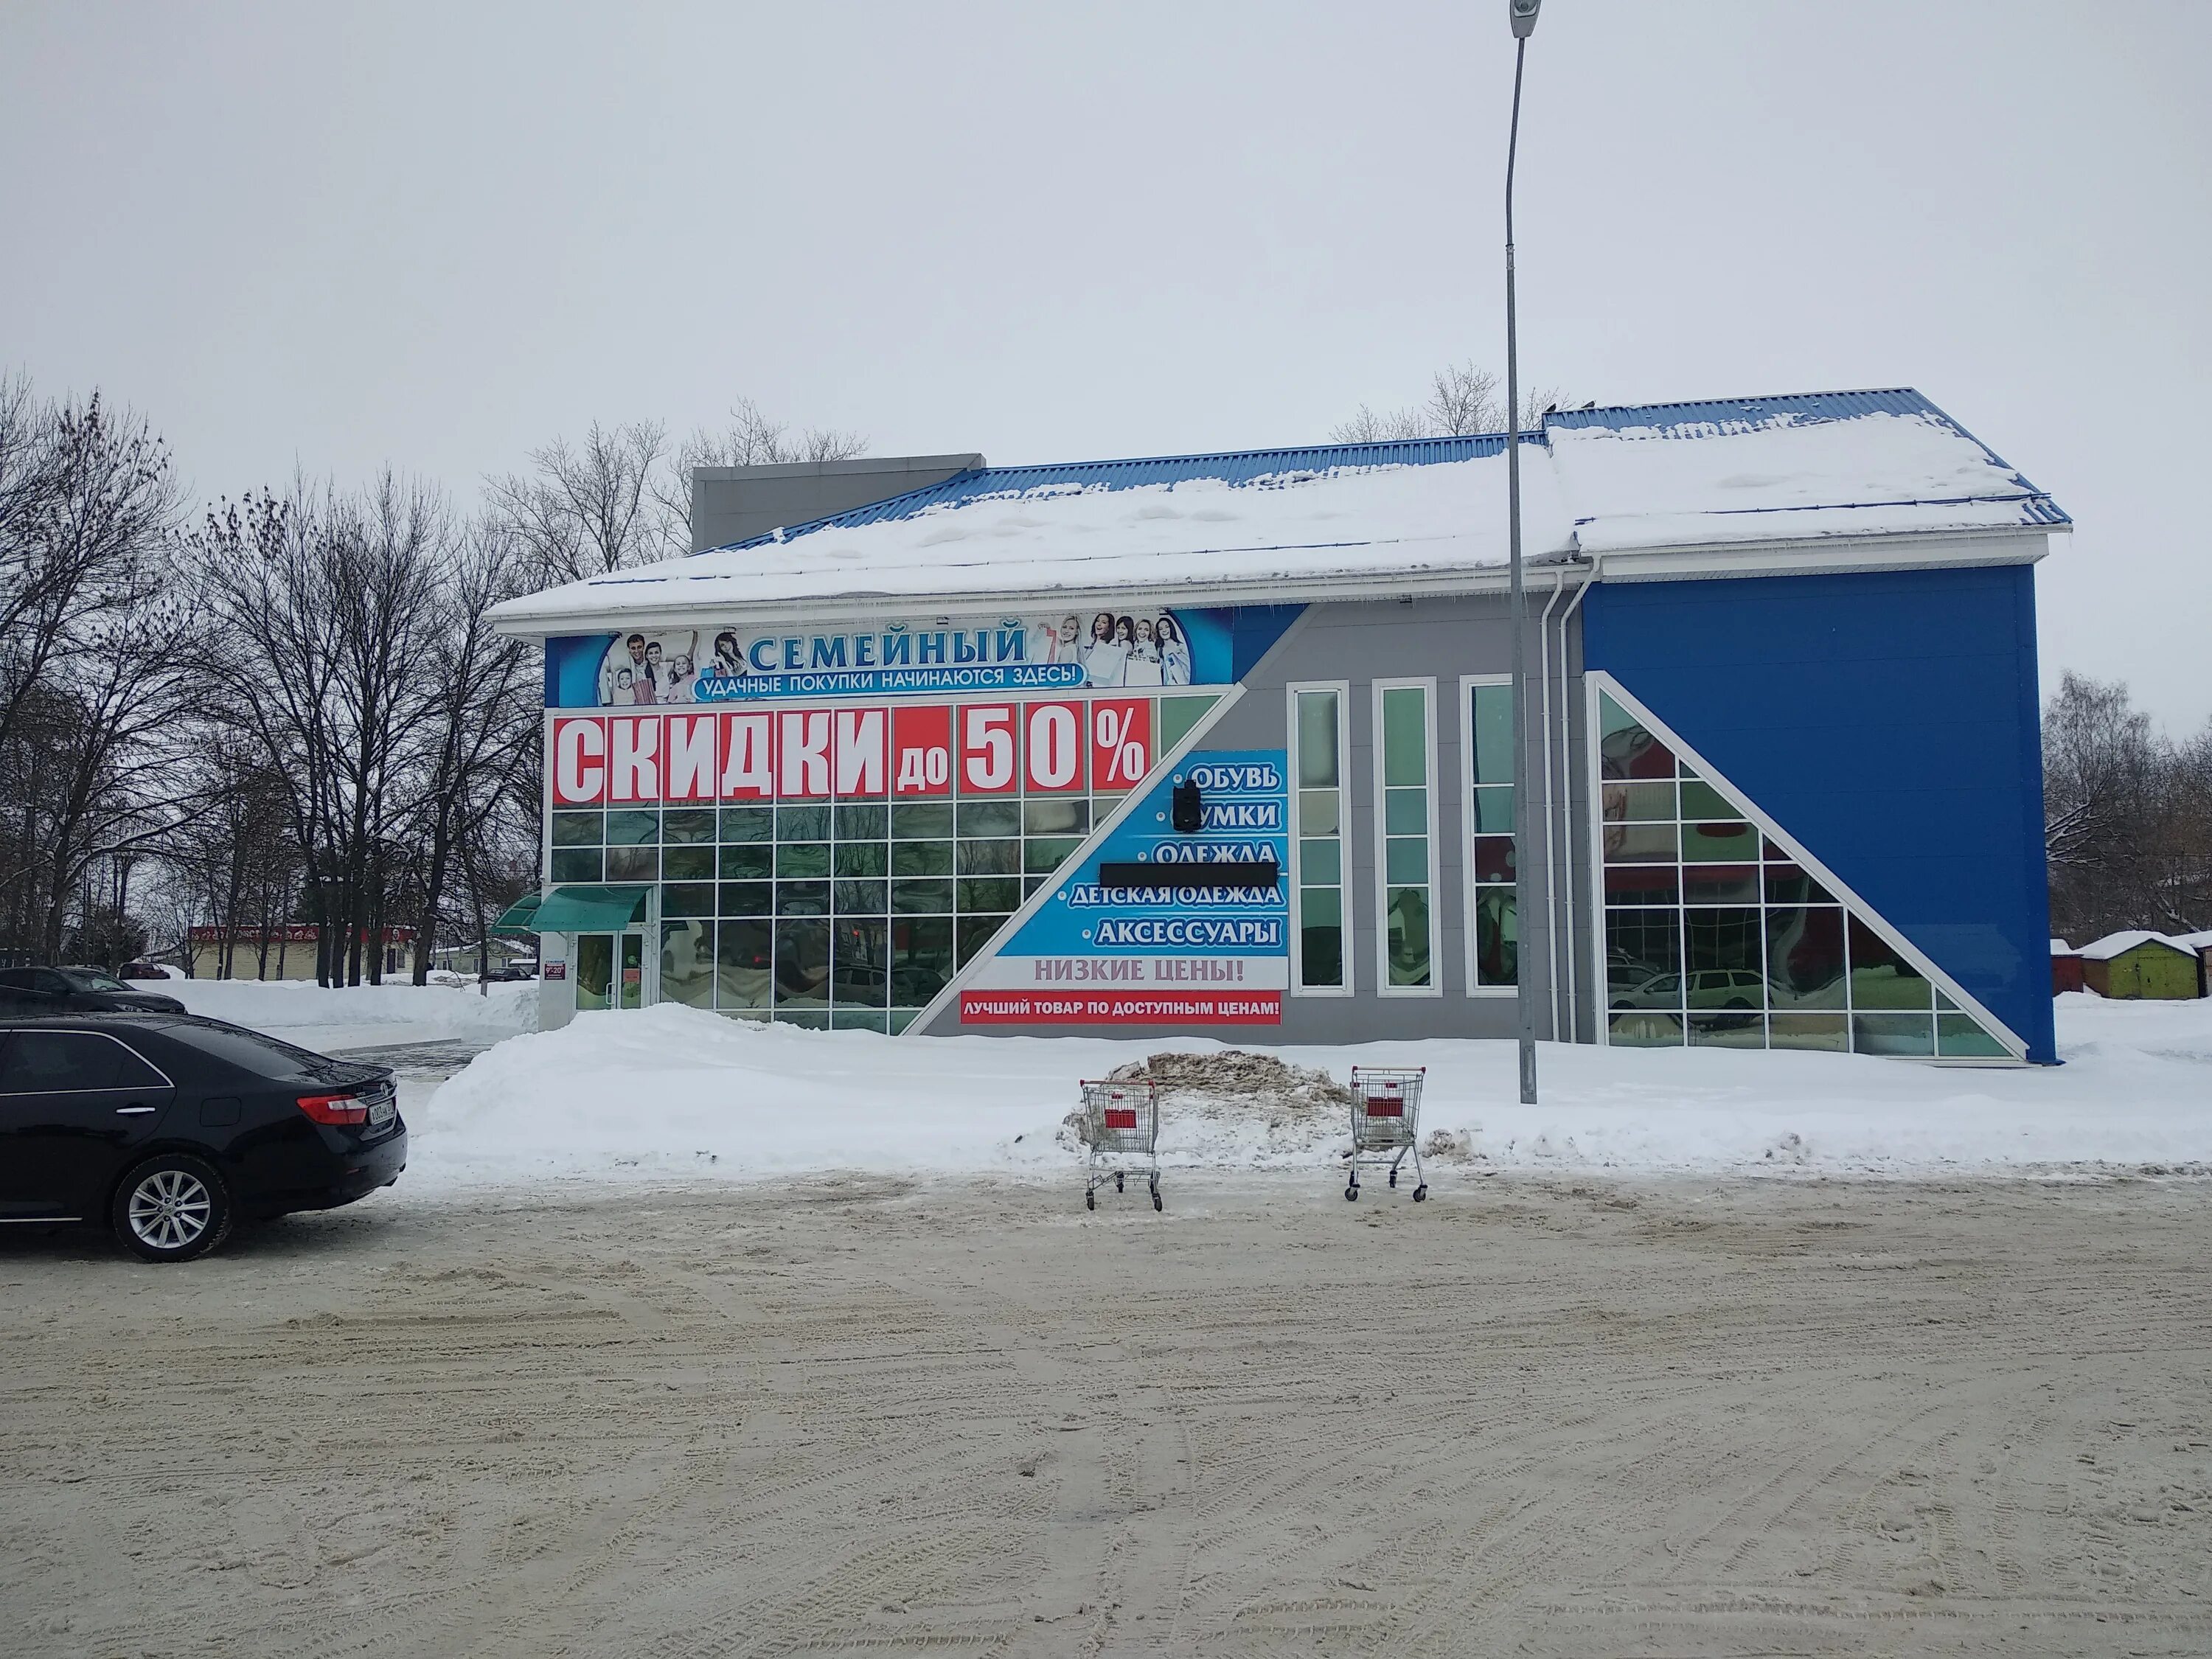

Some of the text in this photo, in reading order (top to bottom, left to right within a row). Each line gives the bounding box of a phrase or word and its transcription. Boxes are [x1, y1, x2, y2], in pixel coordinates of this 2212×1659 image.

[748, 619, 1026, 672] СЕМЕЙНЫЙ
[702, 666, 1076, 697] УДАЧНЫЕ ПОКУПКИ НАЧИНАЮТСЯ ЗДЕСЬ!
[556, 711, 884, 802] СКИДКИ
[965, 705, 1144, 789] 50%
[1191, 766, 1278, 788] ОБУВЬ
[1200, 804, 1276, 827] УМКИ
[1156, 843, 1276, 863] ОДЕЖДА
[1071, 886, 1283, 905] ДЕТСКАЯ ОДЕЖДА
[1097, 922, 1278, 944] АКСЕССУАРЫ
[1034, 959, 1245, 981] НИЗКИЕ ЦЕНЫ!
[964, 998, 1280, 1017] ЛУЧШИЙ ТОВАР ПО ДОСТУПНЫМ ЦЕНАМ!
